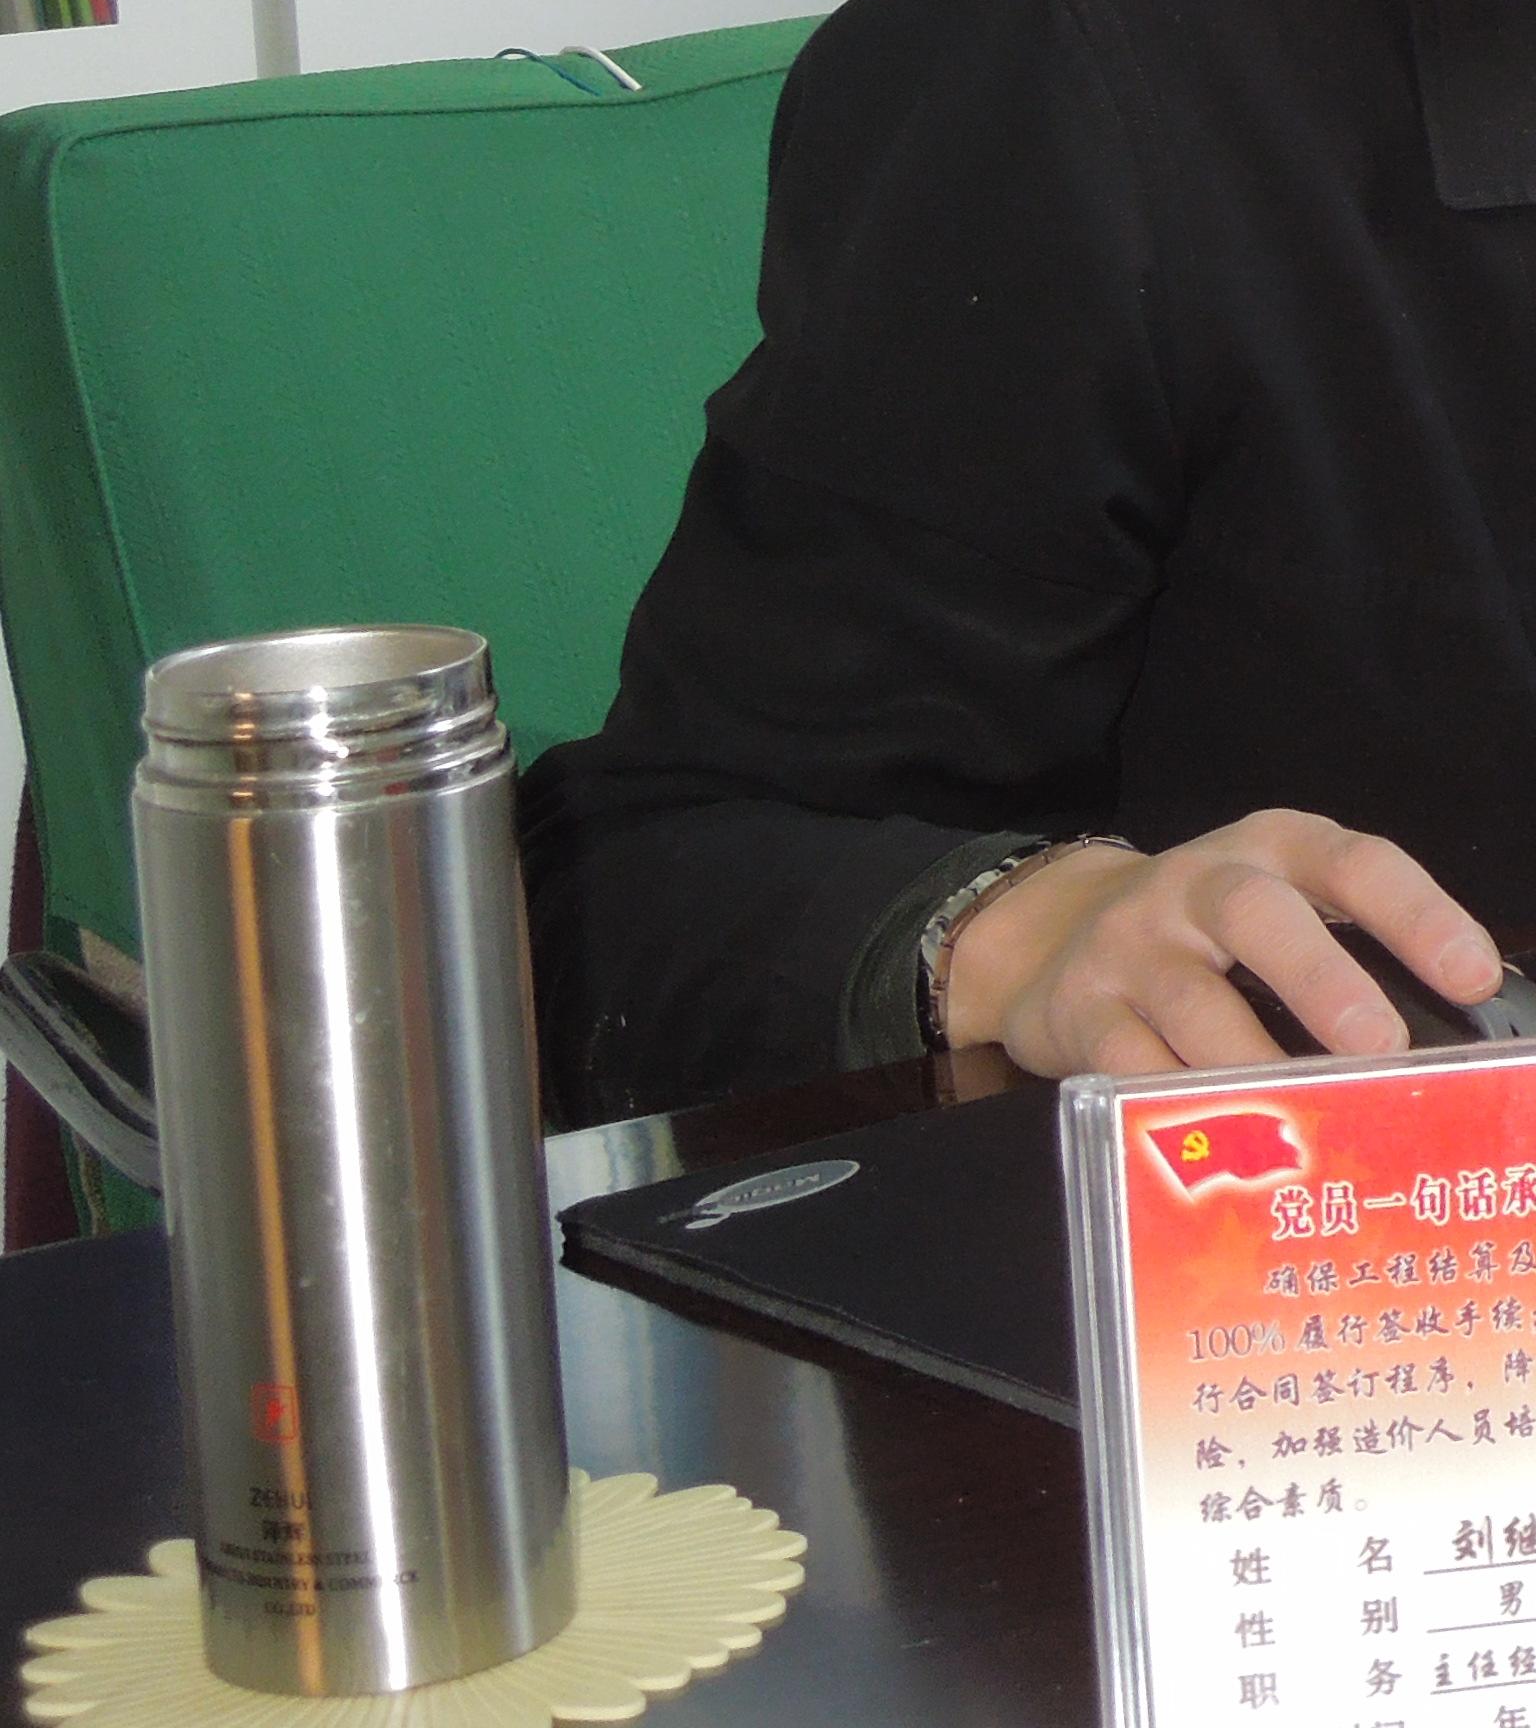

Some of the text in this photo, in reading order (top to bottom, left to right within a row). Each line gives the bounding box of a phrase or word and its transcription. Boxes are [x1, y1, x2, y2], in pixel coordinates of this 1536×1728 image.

[1200, 1477, 1368, 1524] 综合素质。
[1499, 1581, 1524, 1617] 男
